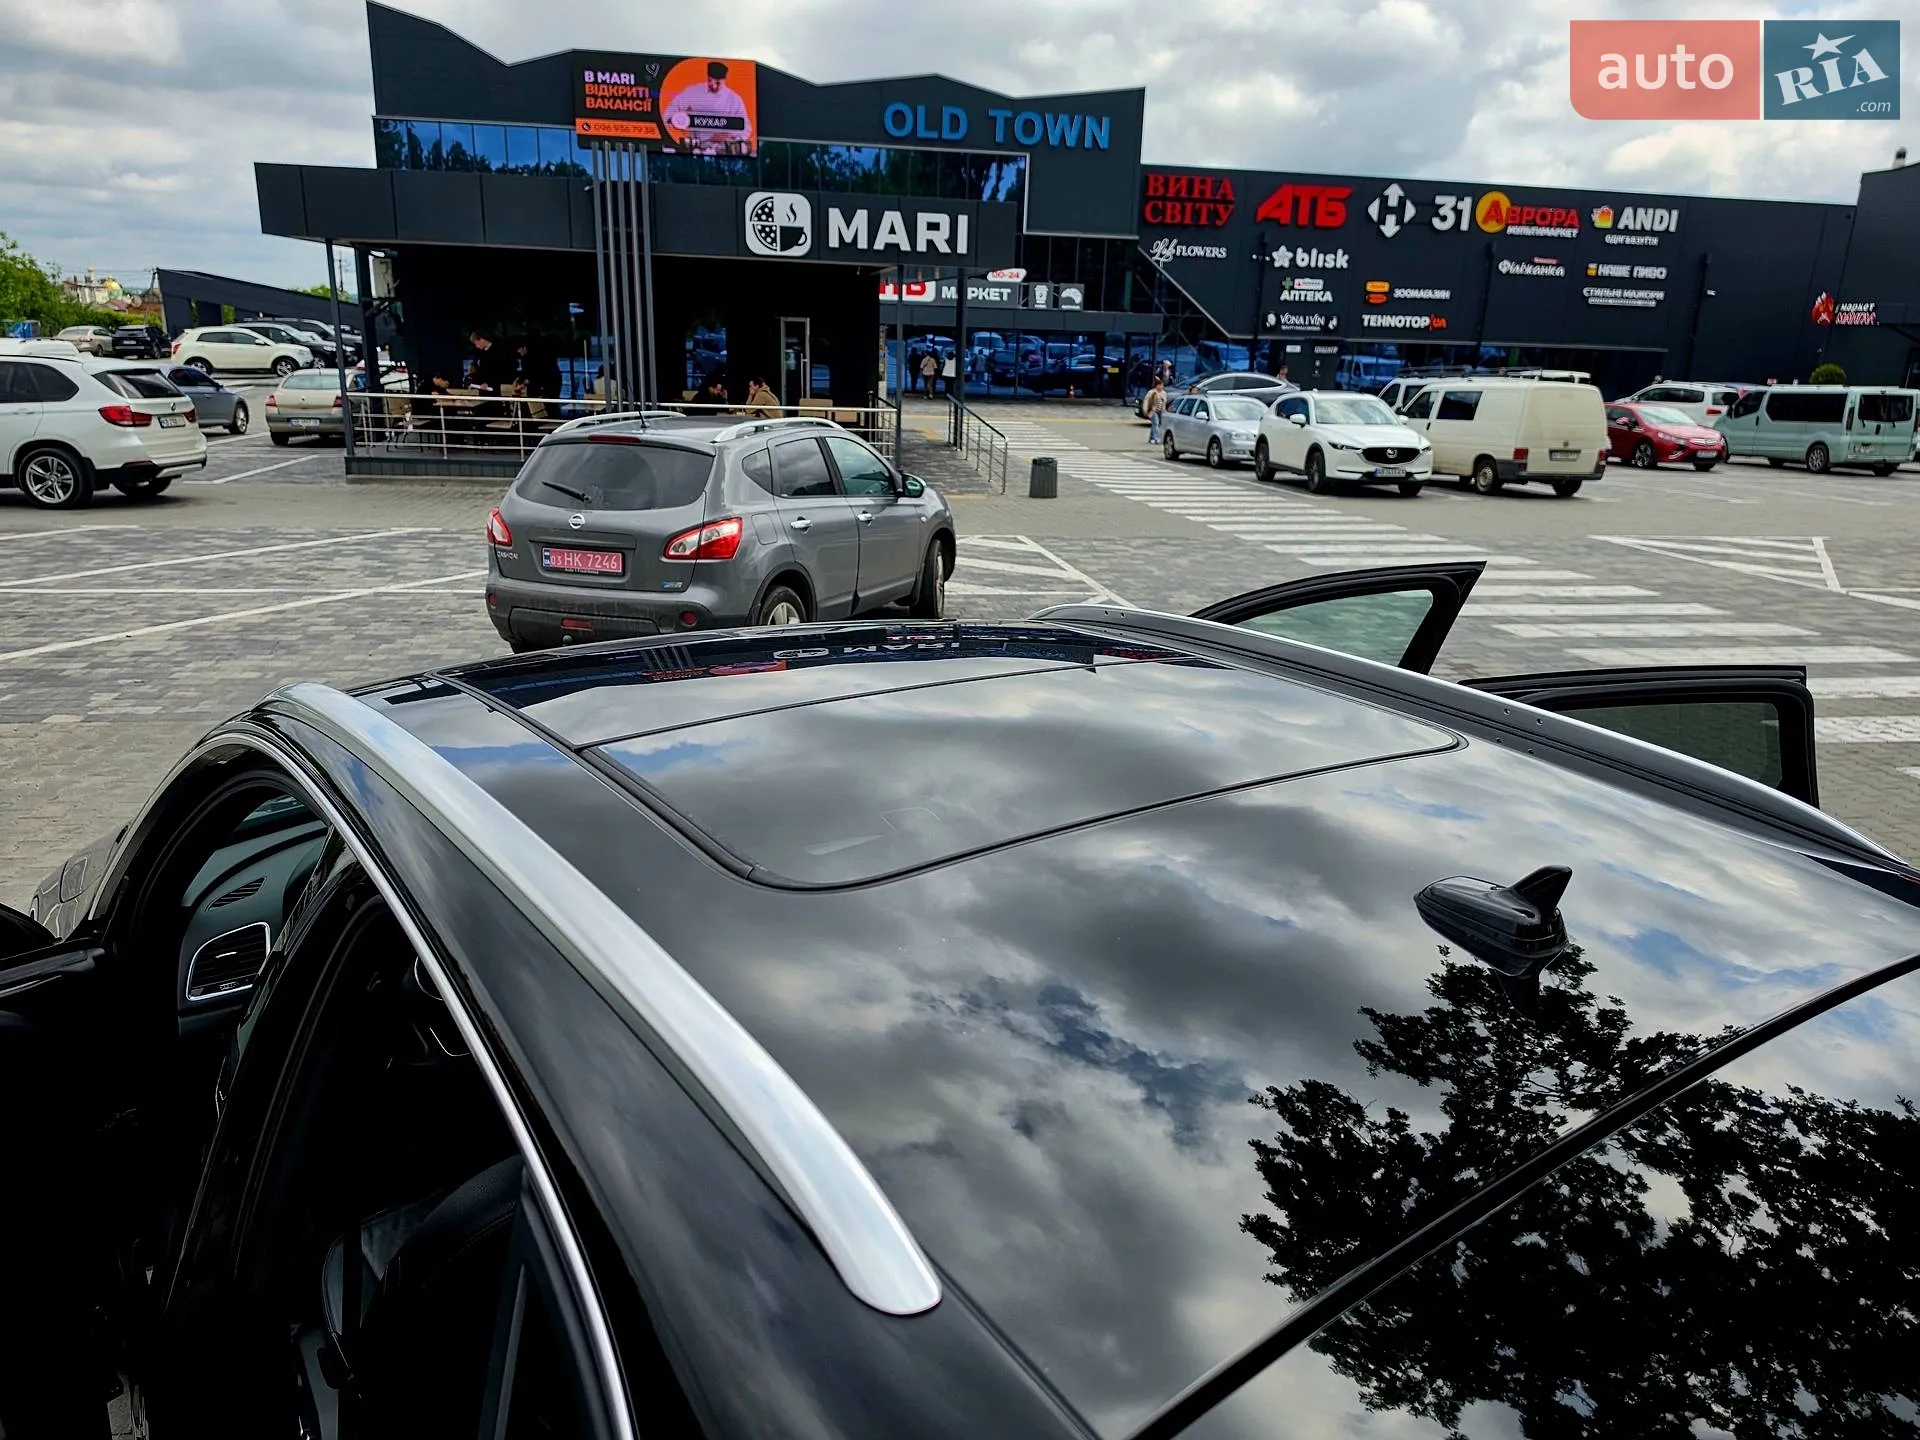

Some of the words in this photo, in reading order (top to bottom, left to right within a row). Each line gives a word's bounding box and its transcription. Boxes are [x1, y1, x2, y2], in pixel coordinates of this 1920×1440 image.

[585, 84, 650, 98] ВІДКРИТІ
[586, 97, 652, 112] ВАКАНСІЇ
[884, 103, 969, 141] OLD
[988, 109, 1111, 149] TOWN
[1145, 173, 1235, 200] ВИНА
[1144, 202, 1236, 227] СВІТУ
[1256, 184, 1354, 228] АТБ
[1431, 195, 1472, 231] 31
[1482, 200, 1580, 228] АВРОРА
[828, 207, 969, 255] MARI
[1617, 206, 1679, 232] ANDI
[1176, 245, 1227, 258] FLOWERS
[1296, 248, 1349, 269] blisk
[941, 286, 1011, 301] МРКЕТ
[1280, 290, 1333, 302] АПТЕКА
[550, 556, 562, 566] 03
[564, 553, 582, 567] HK
[587, 554, 617, 569] 7246
